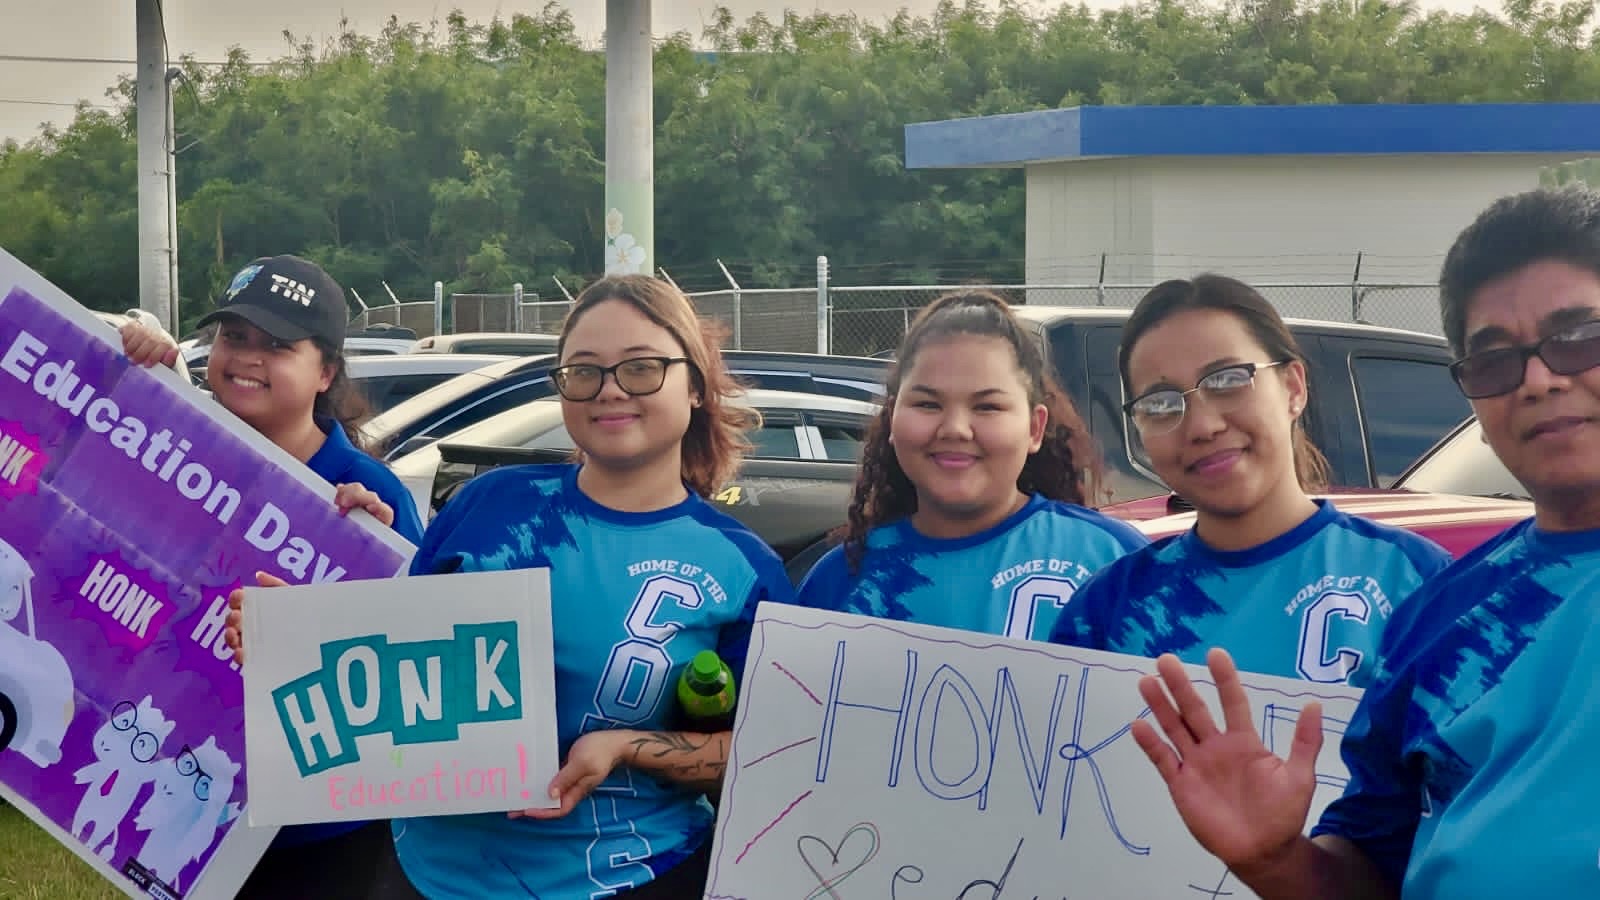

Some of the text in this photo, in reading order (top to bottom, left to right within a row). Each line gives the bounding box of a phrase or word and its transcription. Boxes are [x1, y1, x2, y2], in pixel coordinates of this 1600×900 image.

[270, 273, 316, 307] TIN
[0, 428, 34, 486] NK
[1, 330, 242, 525] Education
[79, 559, 164, 639] HONK
[627, 559, 728, 604] HOME OF THE
[991, 559, 1046, 590] HOME
[1047, 558, 1074, 574] OF
[1284, 575, 1393, 620] HOME OF THE
[282, 636, 517, 768] HONK
[328, 741, 532, 811] Education!
[815, 640, 1152, 856] HONK
